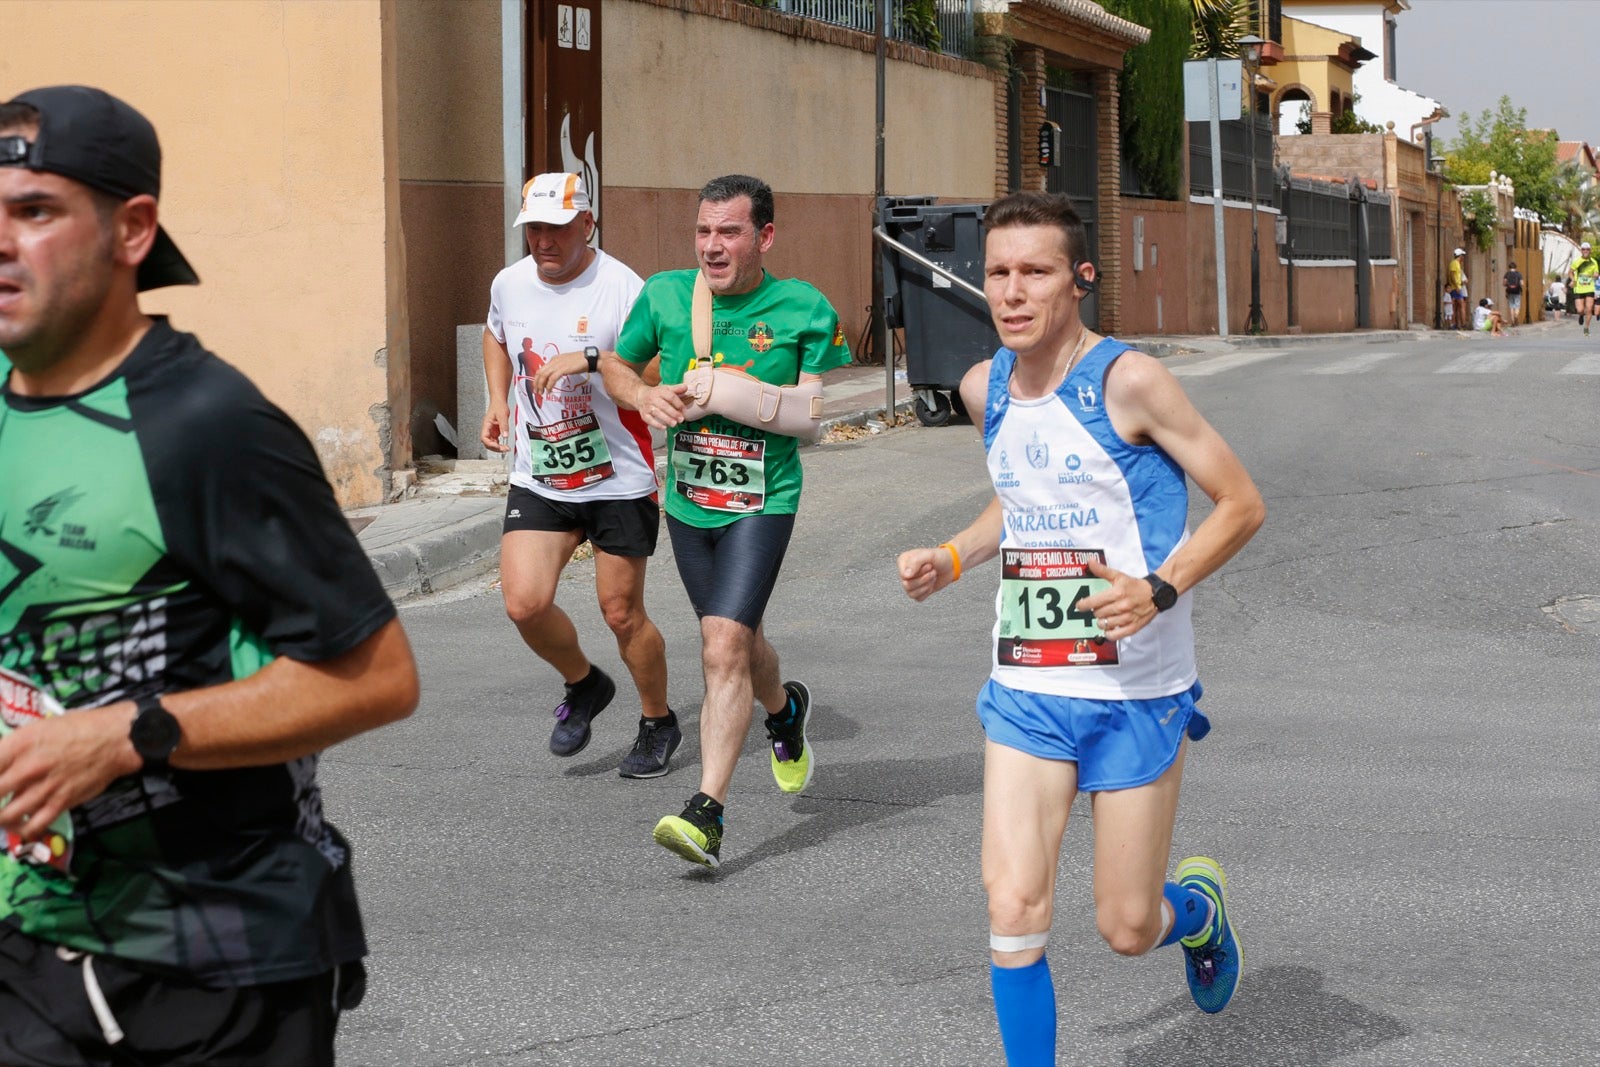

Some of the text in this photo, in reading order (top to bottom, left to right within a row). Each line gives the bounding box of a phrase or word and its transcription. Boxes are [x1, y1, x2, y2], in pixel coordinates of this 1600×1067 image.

[567, 420, 574, 429] DE
[574, 415, 593, 427] FONDO
[693, 434, 708, 446] GRAN
[708, 436, 730, 449] PREMIO
[730, 439, 739, 450] DE
[542, 437, 596, 469] 355
[688, 457, 750, 486] 763
[1058, 472, 1093, 485] mayfo
[1036, 502, 1079, 512] ATLETISMO
[1033, 552, 1063, 566] PREMIO
[1064, 552, 1074, 565] DE
[1046, 567, 1083, 578] CRUZCAMPO
[1018, 585, 1096, 630] 134
